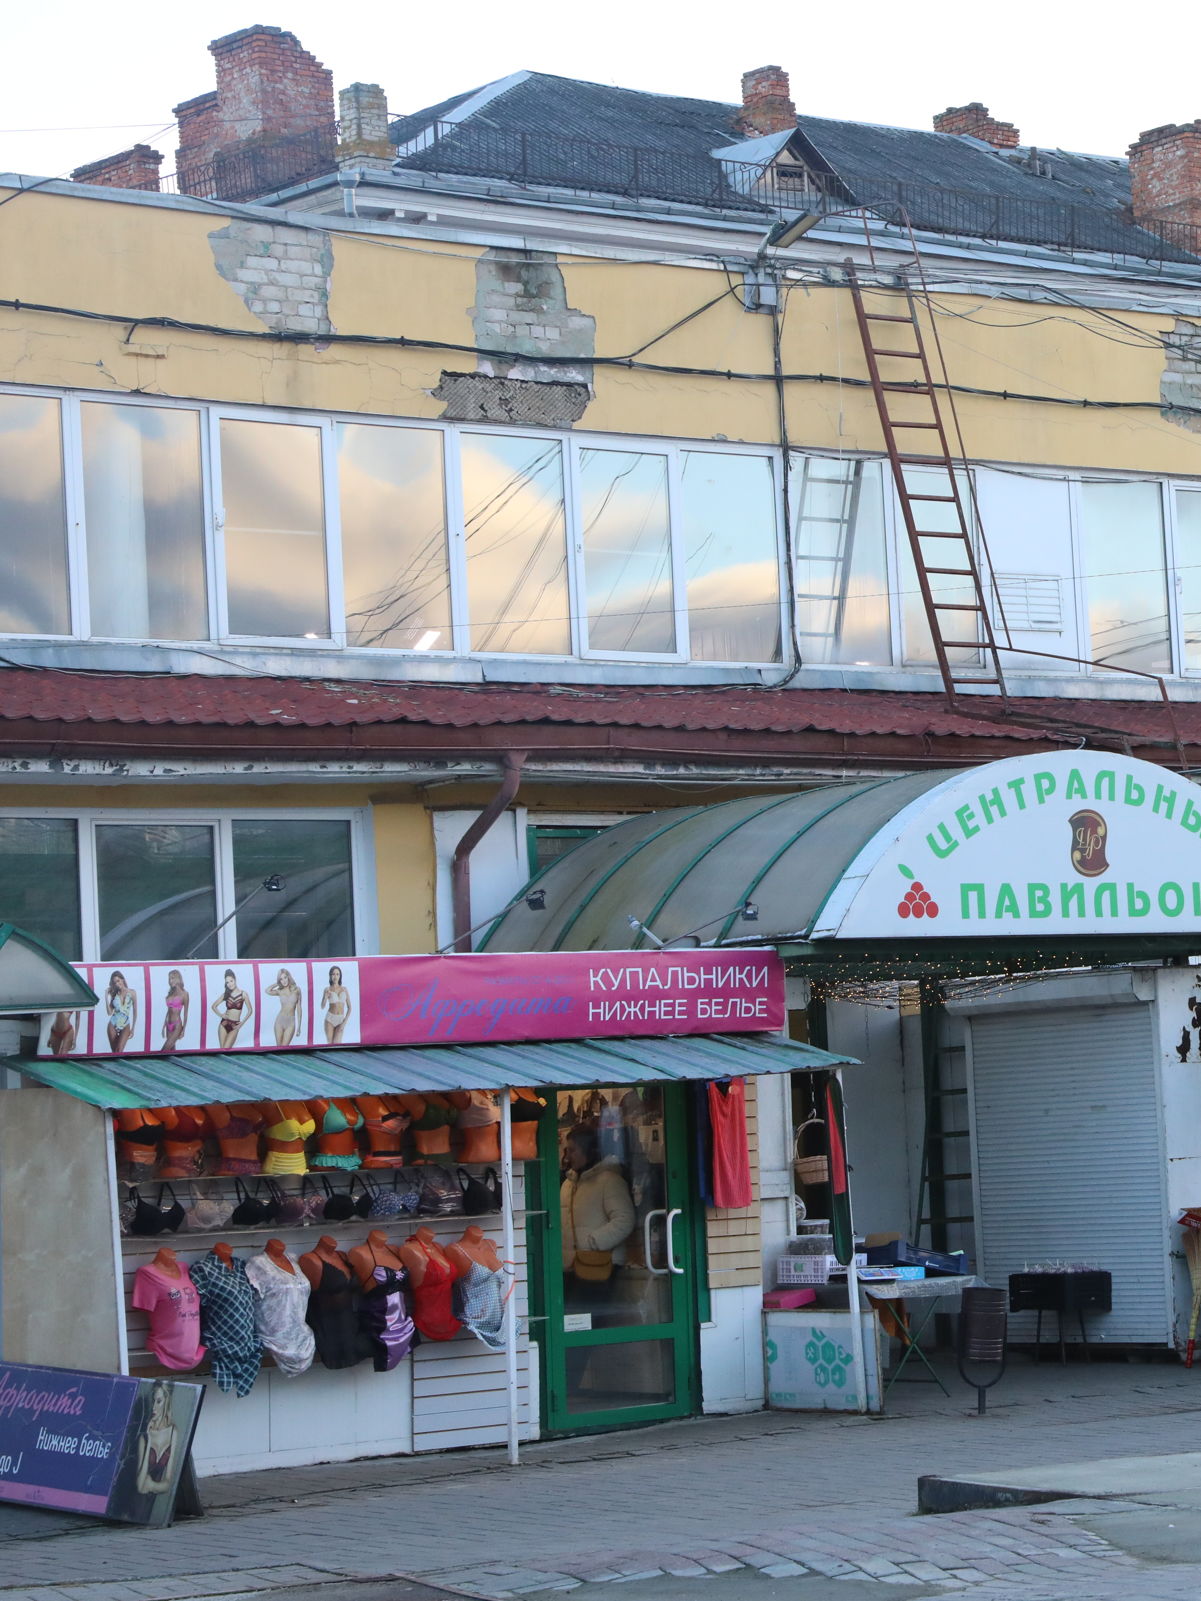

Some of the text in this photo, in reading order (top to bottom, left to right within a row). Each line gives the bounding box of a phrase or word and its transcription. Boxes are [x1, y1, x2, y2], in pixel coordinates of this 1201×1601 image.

[589, 966, 769, 991] КУПАЛЬНИКИ
[378, 977, 575, 1036] Афродита
[588, 997, 768, 1021] НИЖНЕЕ БЕЛЬЕ
[36, 1426, 111, 1459] Нижнее белье
